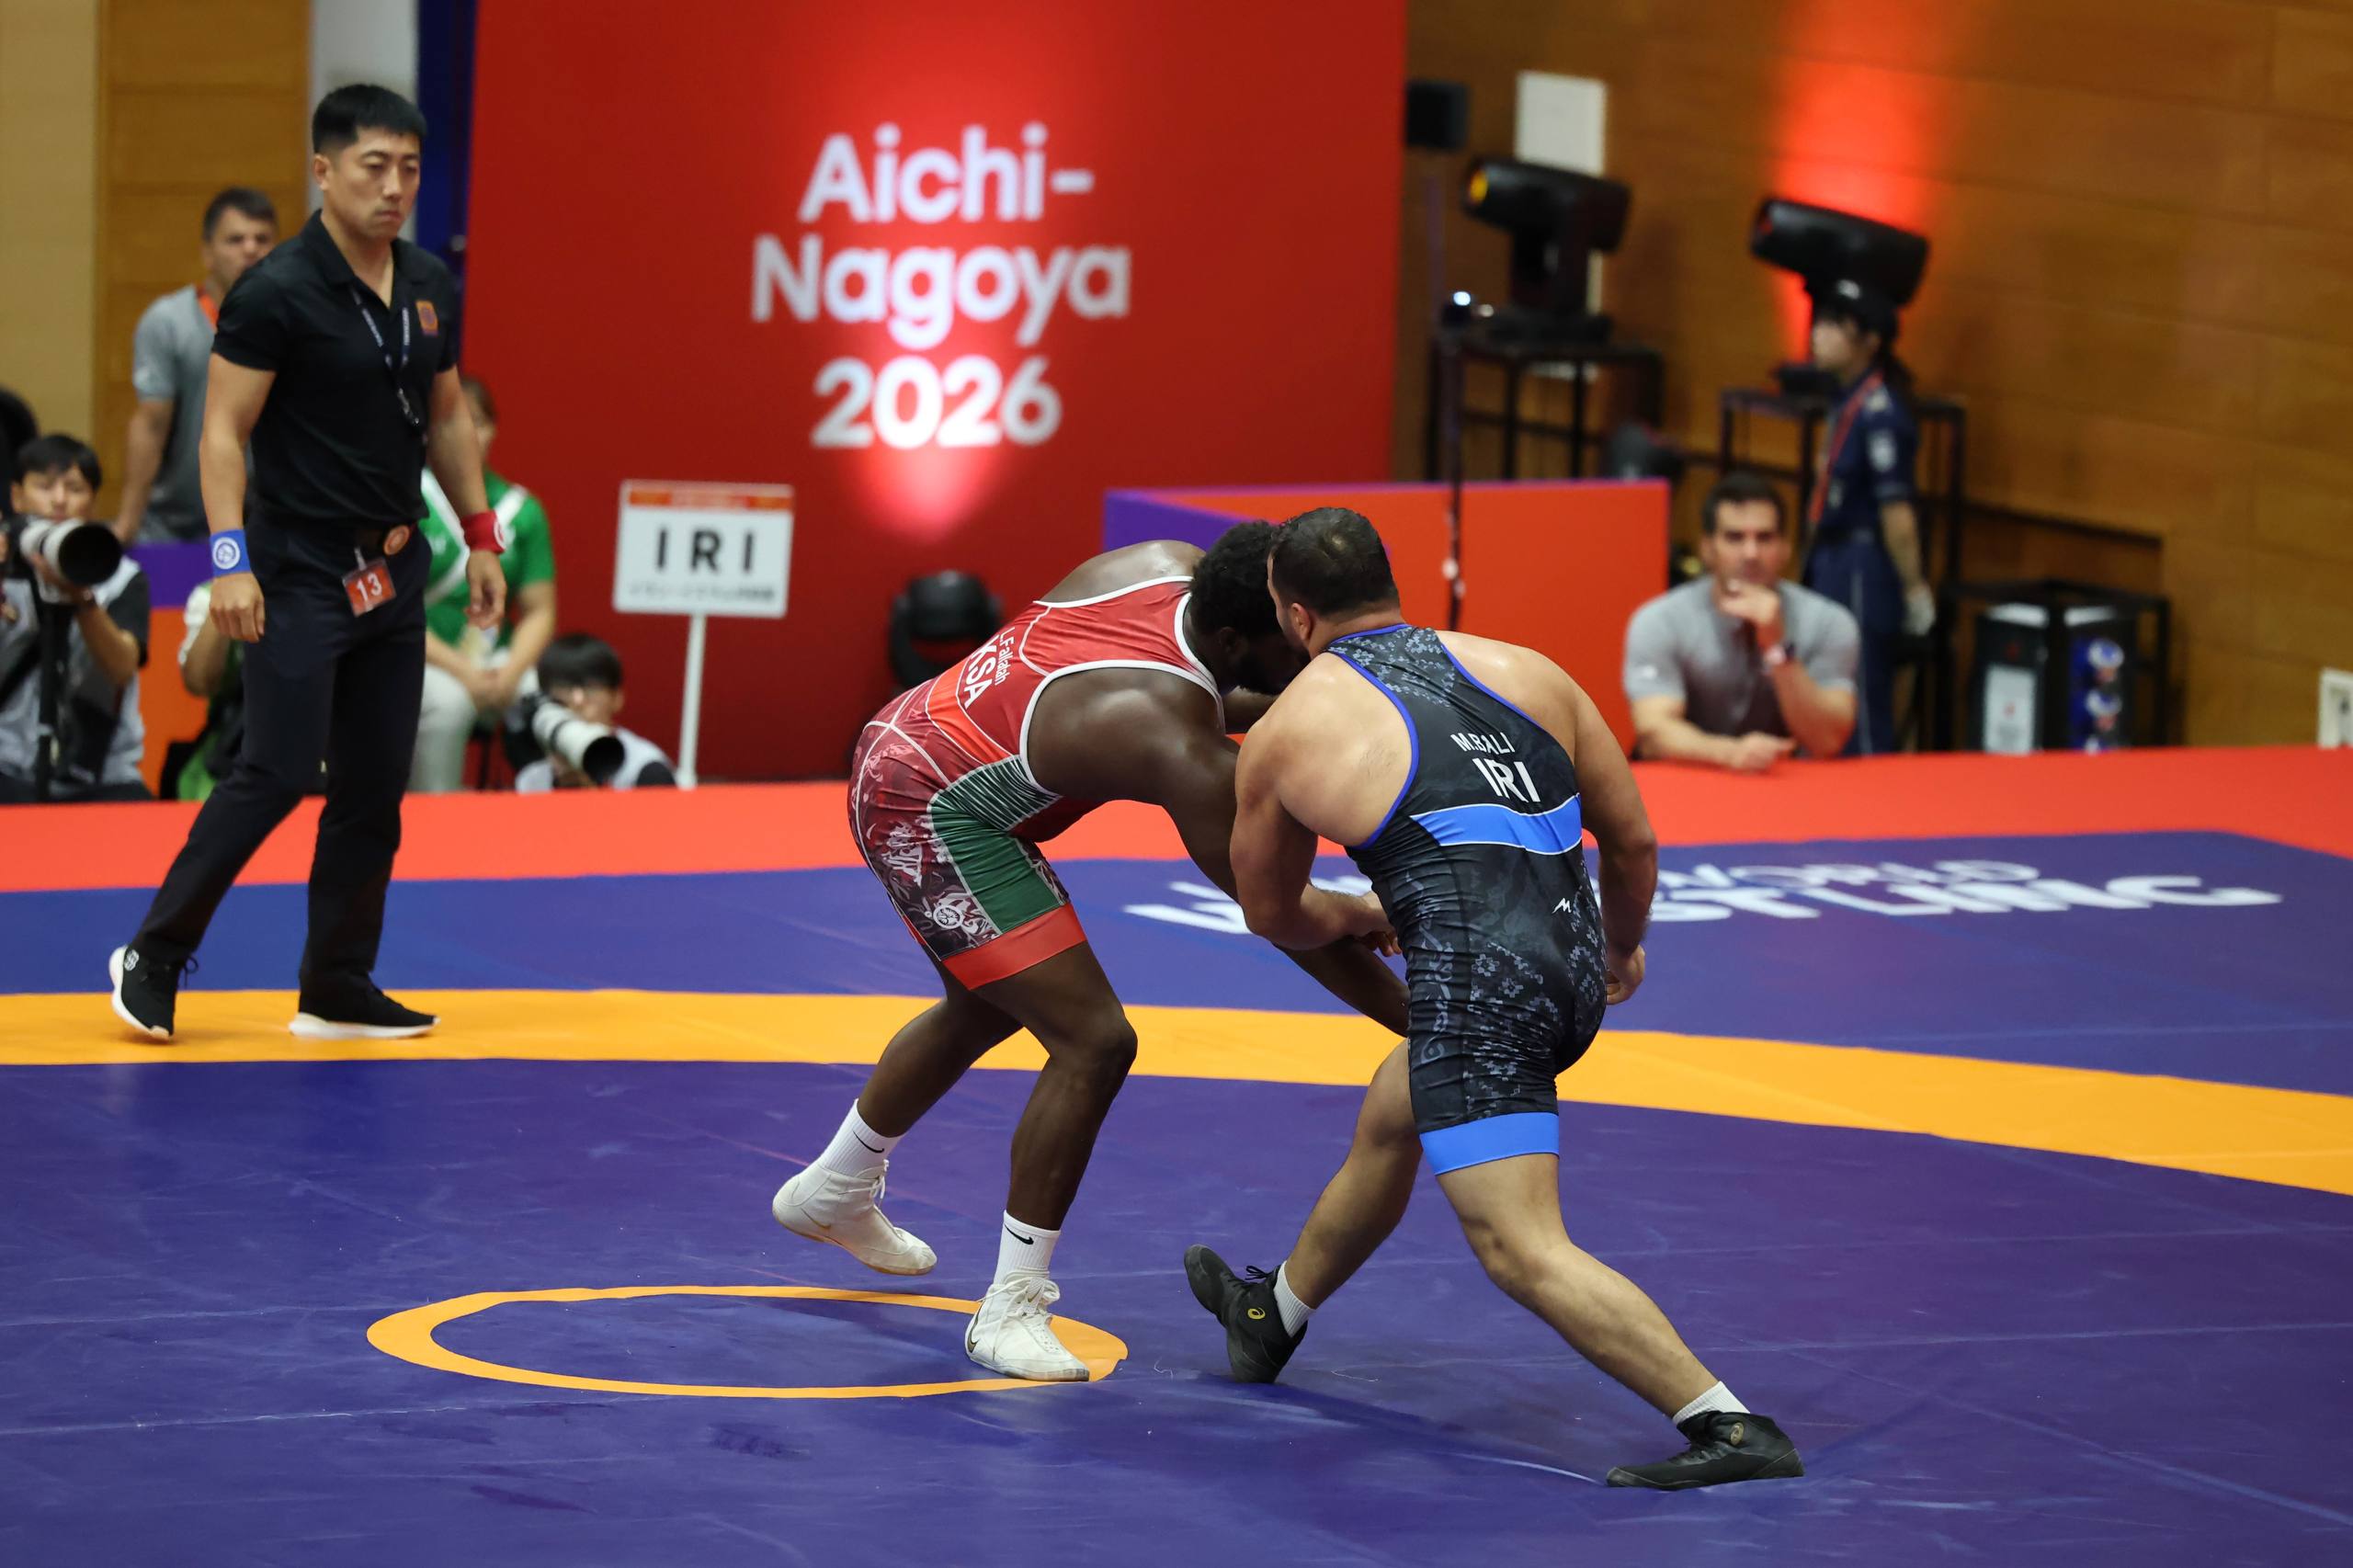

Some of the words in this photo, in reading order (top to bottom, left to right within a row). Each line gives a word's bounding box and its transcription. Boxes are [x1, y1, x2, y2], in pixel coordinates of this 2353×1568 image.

[800, 123, 1095, 223] Aichi-
[752, 233, 1130, 349] Nagoya
[812, 356, 1062, 449] 2026
[357, 573, 382, 603] 13
[656, 528, 754, 572] IRI
[963, 633, 999, 710] KSA
[1472, 758, 1540, 802] IRI
